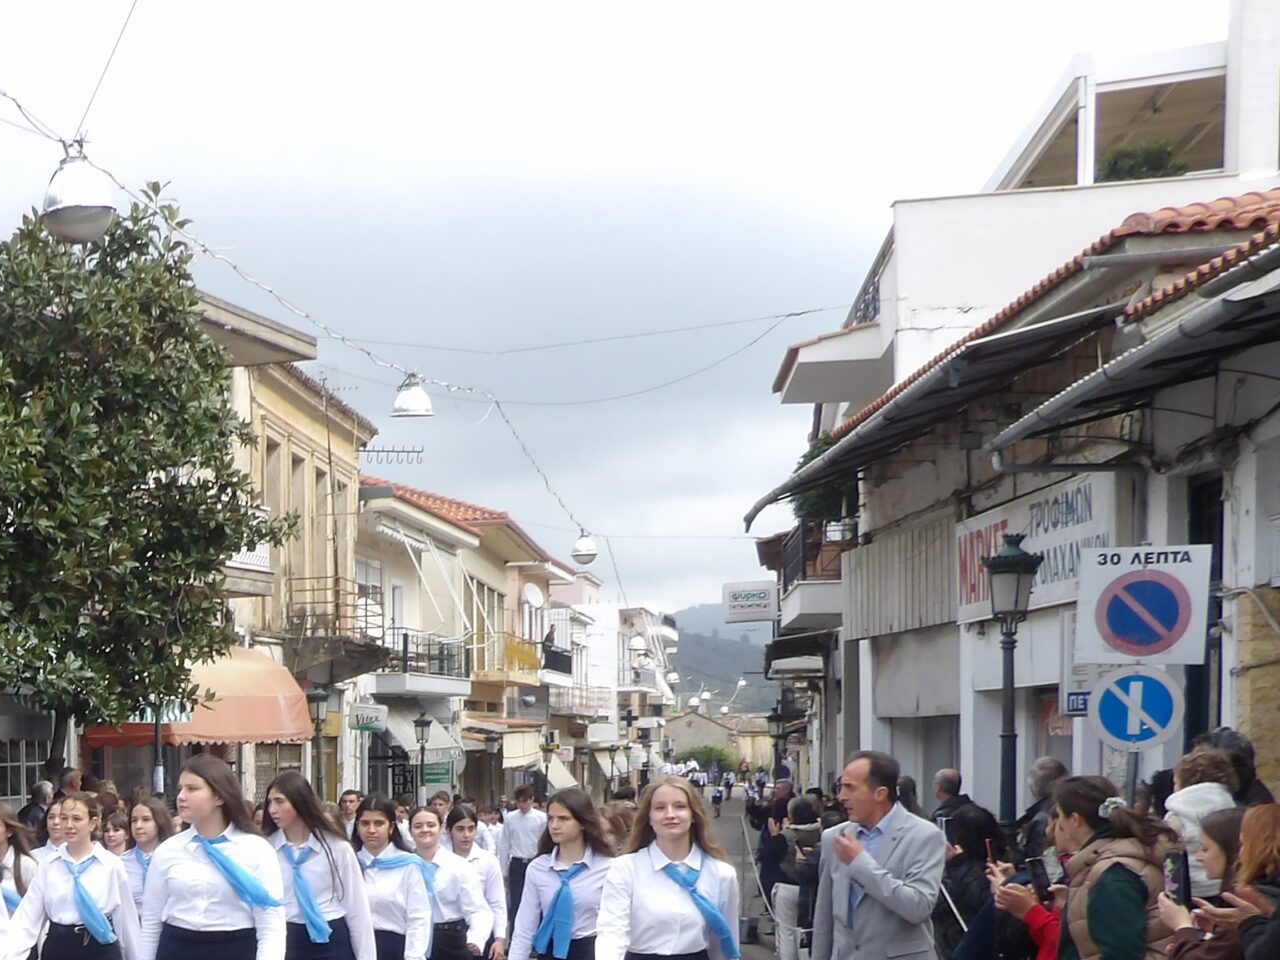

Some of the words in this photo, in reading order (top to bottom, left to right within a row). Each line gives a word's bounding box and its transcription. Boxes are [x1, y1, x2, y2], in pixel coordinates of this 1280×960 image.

[1097, 553, 1121, 566] 30
[1130, 551, 1192, 565] ΛΕΠΤΑ
[355, 713, 380, 727] Vitex
